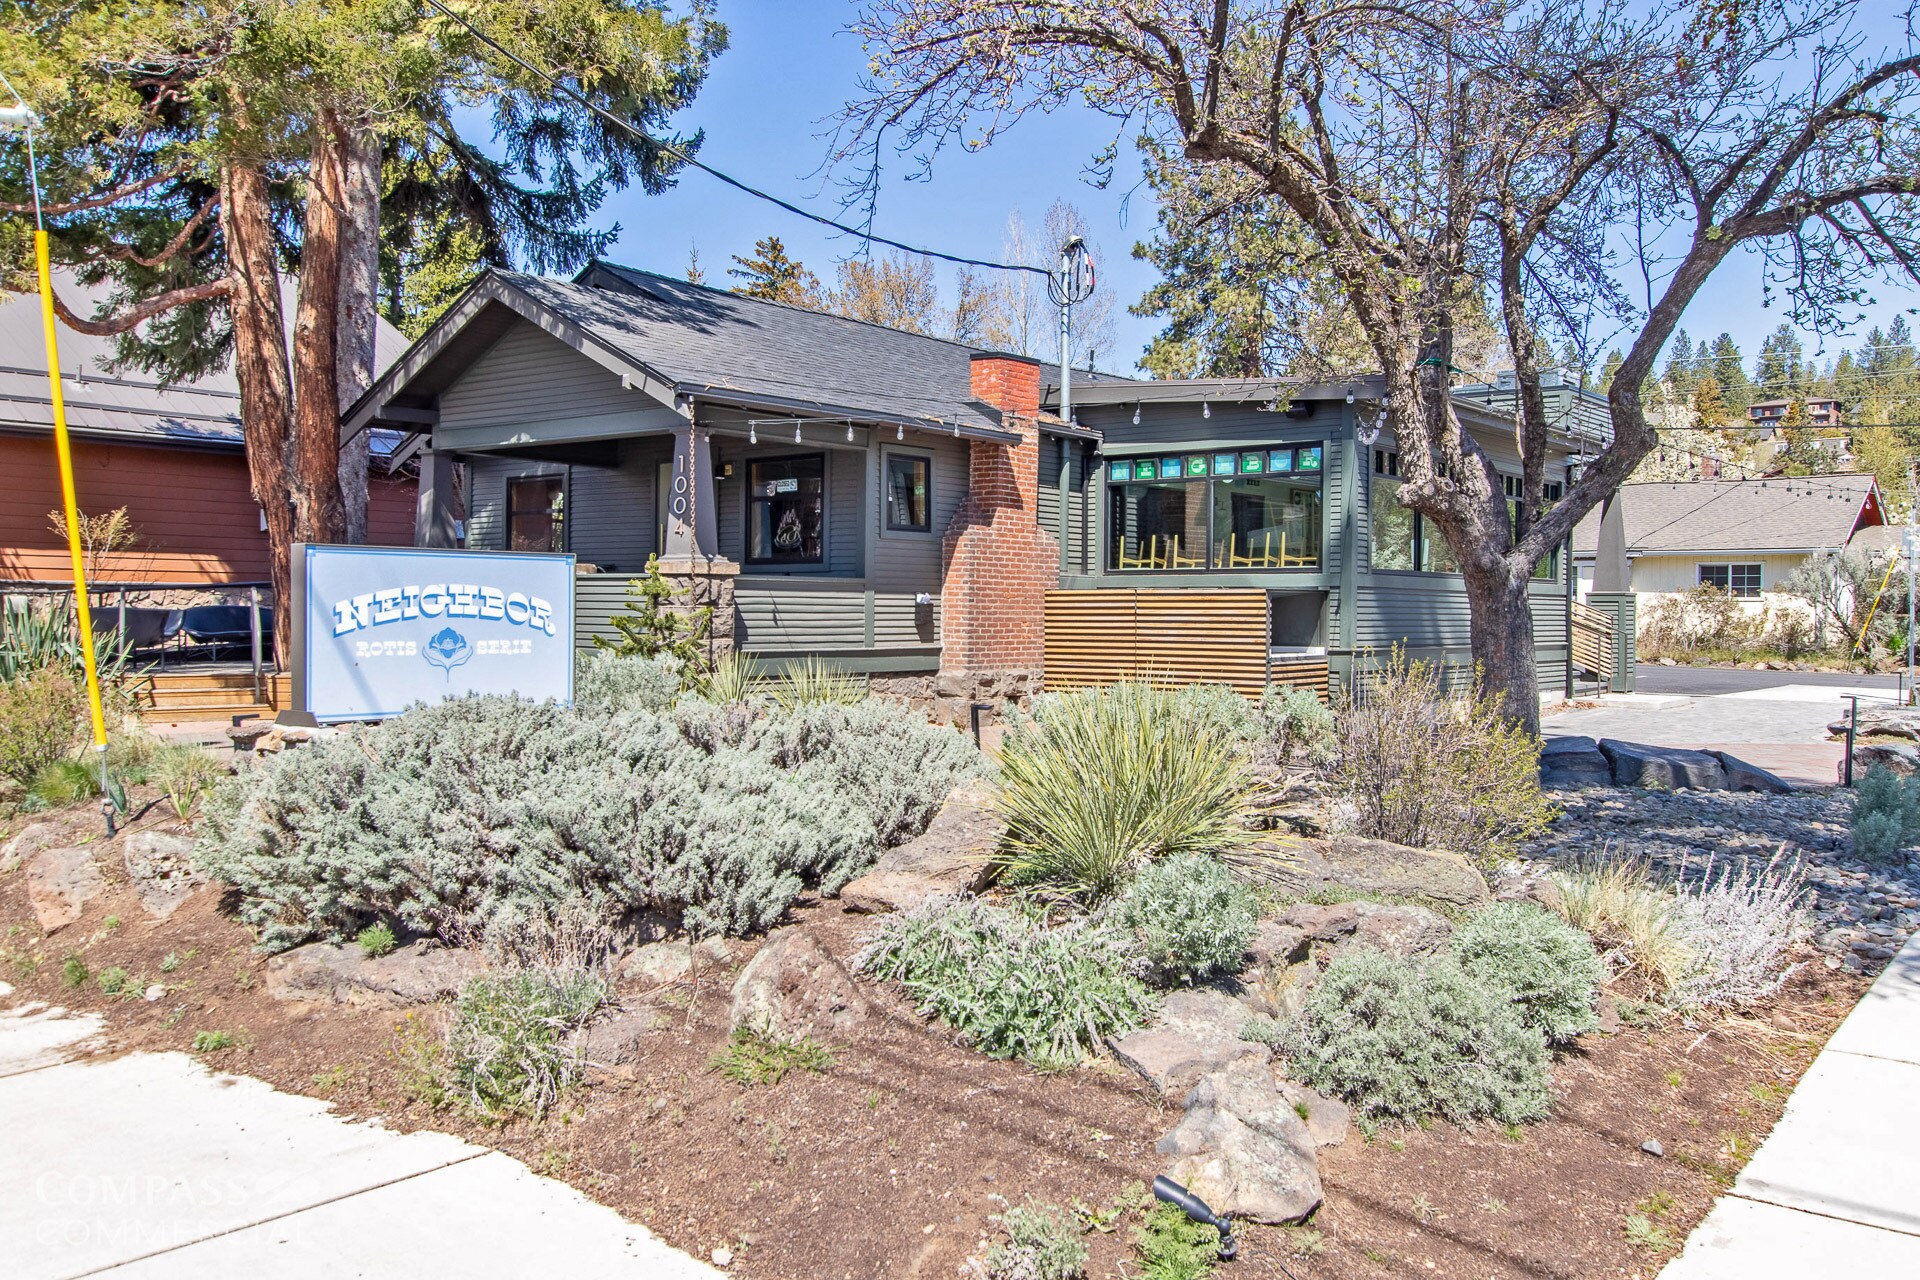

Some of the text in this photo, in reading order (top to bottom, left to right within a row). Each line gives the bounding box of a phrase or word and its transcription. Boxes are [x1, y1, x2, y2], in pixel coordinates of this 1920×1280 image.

[674, 455, 687, 537] 1004
[333, 583, 556, 637] NEIGHBOR
[355, 639, 532, 657] ROTIS SERIE
